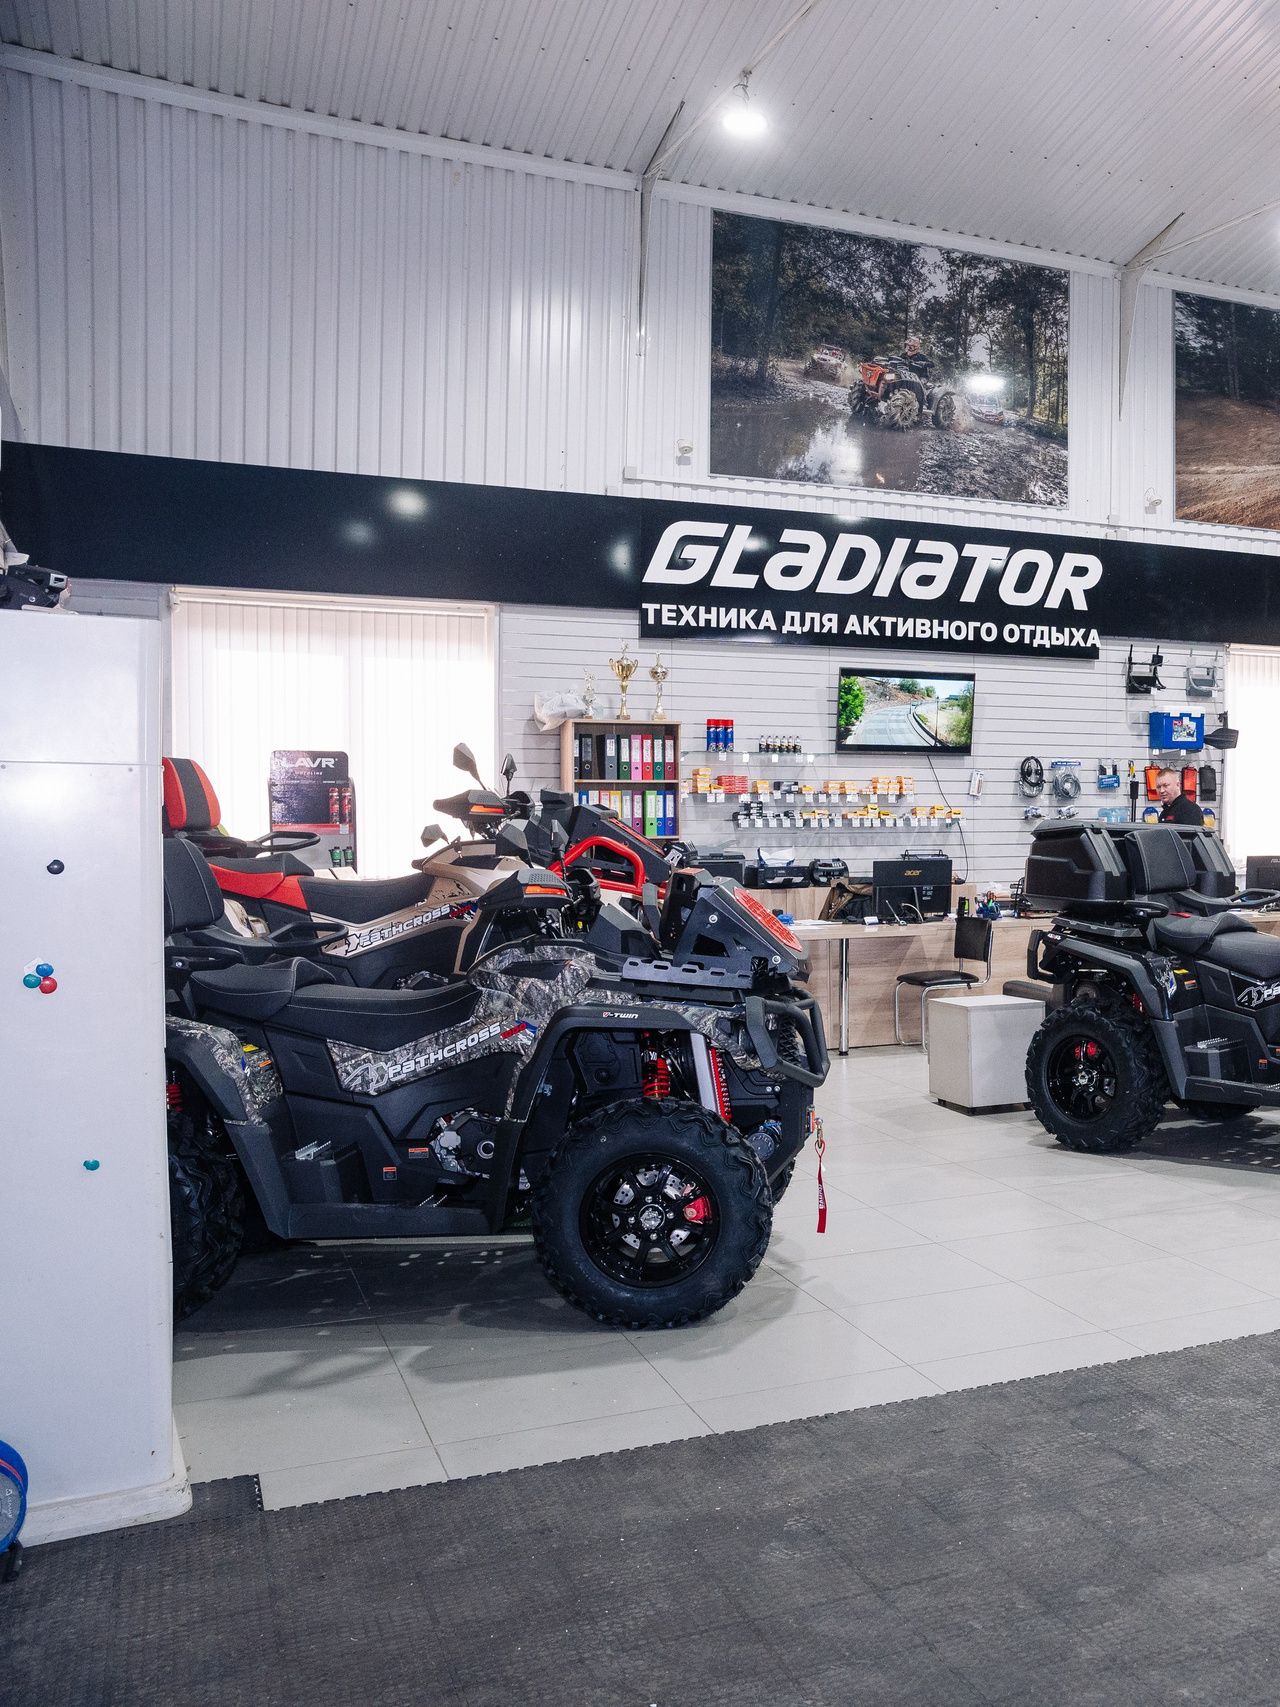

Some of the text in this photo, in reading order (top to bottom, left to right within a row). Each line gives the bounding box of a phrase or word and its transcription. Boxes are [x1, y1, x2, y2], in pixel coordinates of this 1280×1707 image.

[642, 520, 1103, 611] GLADIATOR
[642, 602, 1102, 648] ТЕХНИКА ДЛЯ АКТИВНОГО ОТДЫХА
[360, 904, 450, 946] PATHCROSS
[388, 1022, 501, 1078] PATHCROSS
[500, 1021, 527, 1040] 1000
